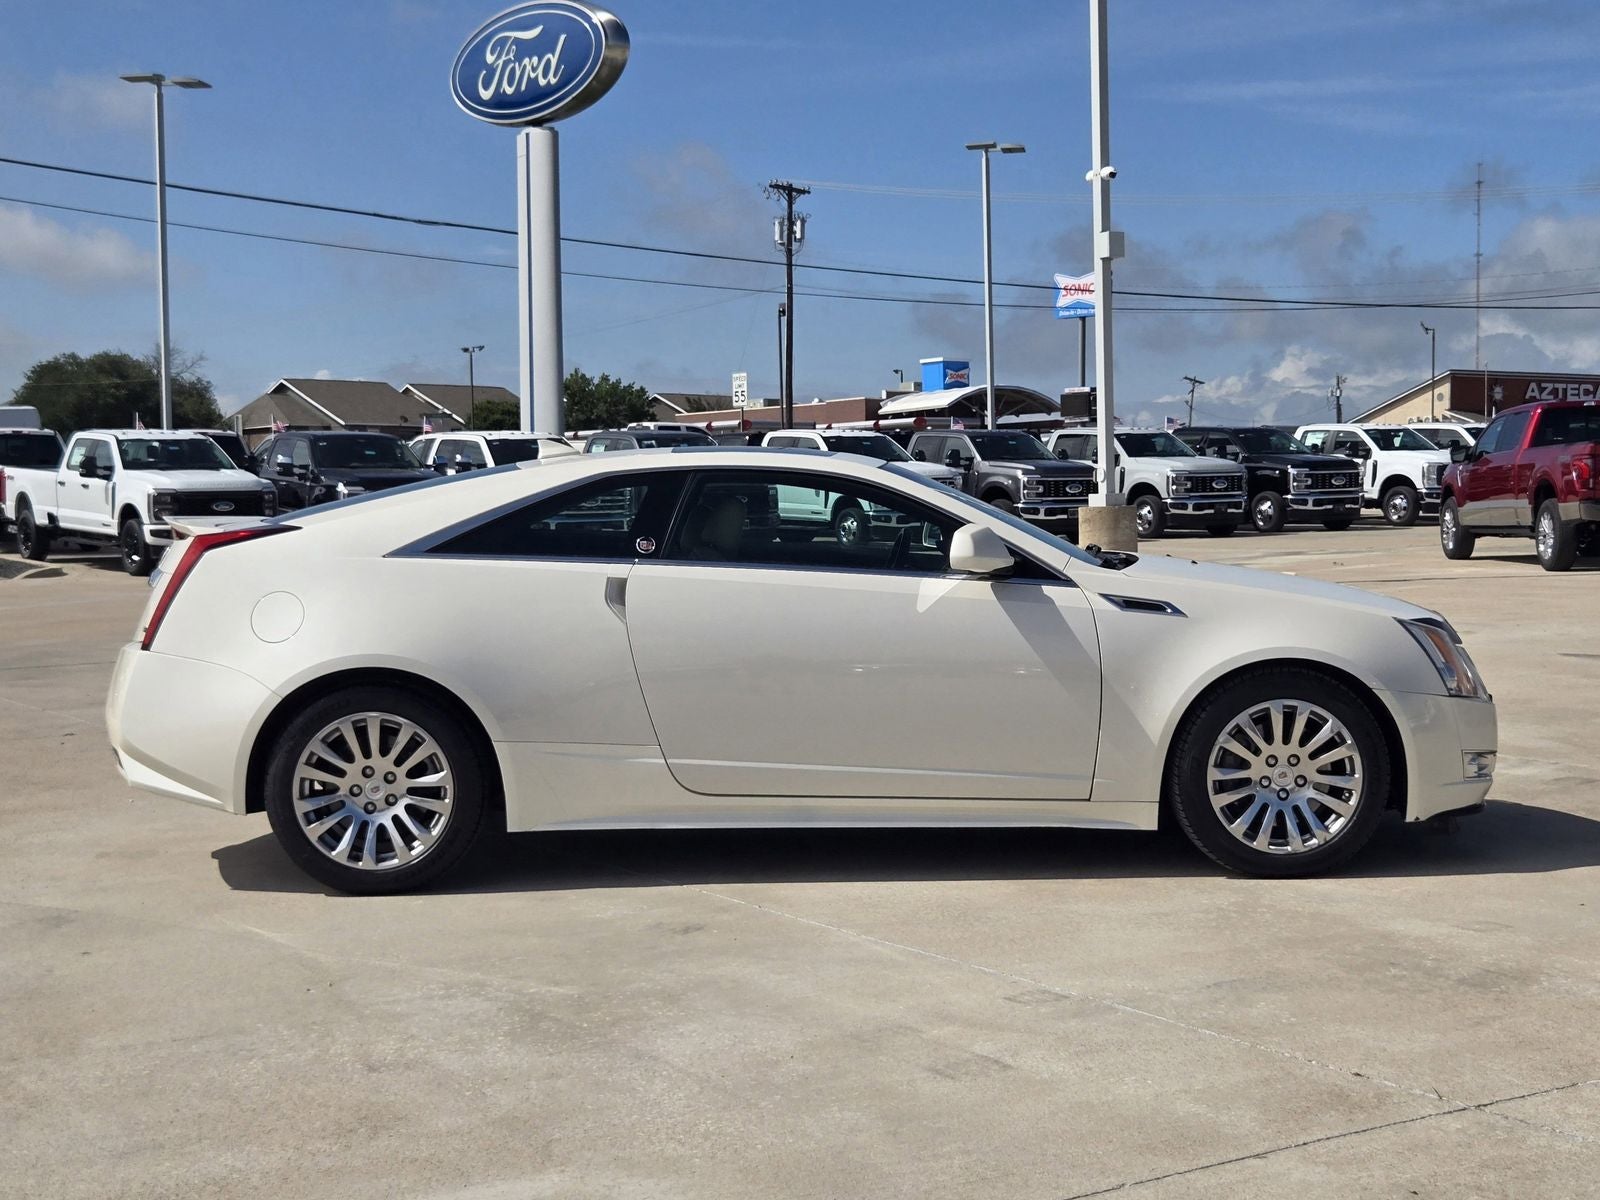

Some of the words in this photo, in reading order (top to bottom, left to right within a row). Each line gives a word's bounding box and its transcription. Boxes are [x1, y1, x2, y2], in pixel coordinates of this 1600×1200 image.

[478, 25, 567, 100] Ford
[1062, 282, 1095, 297] SONIC
[948, 372, 968, 380] SONIC
[734, 390, 747, 403] 55
